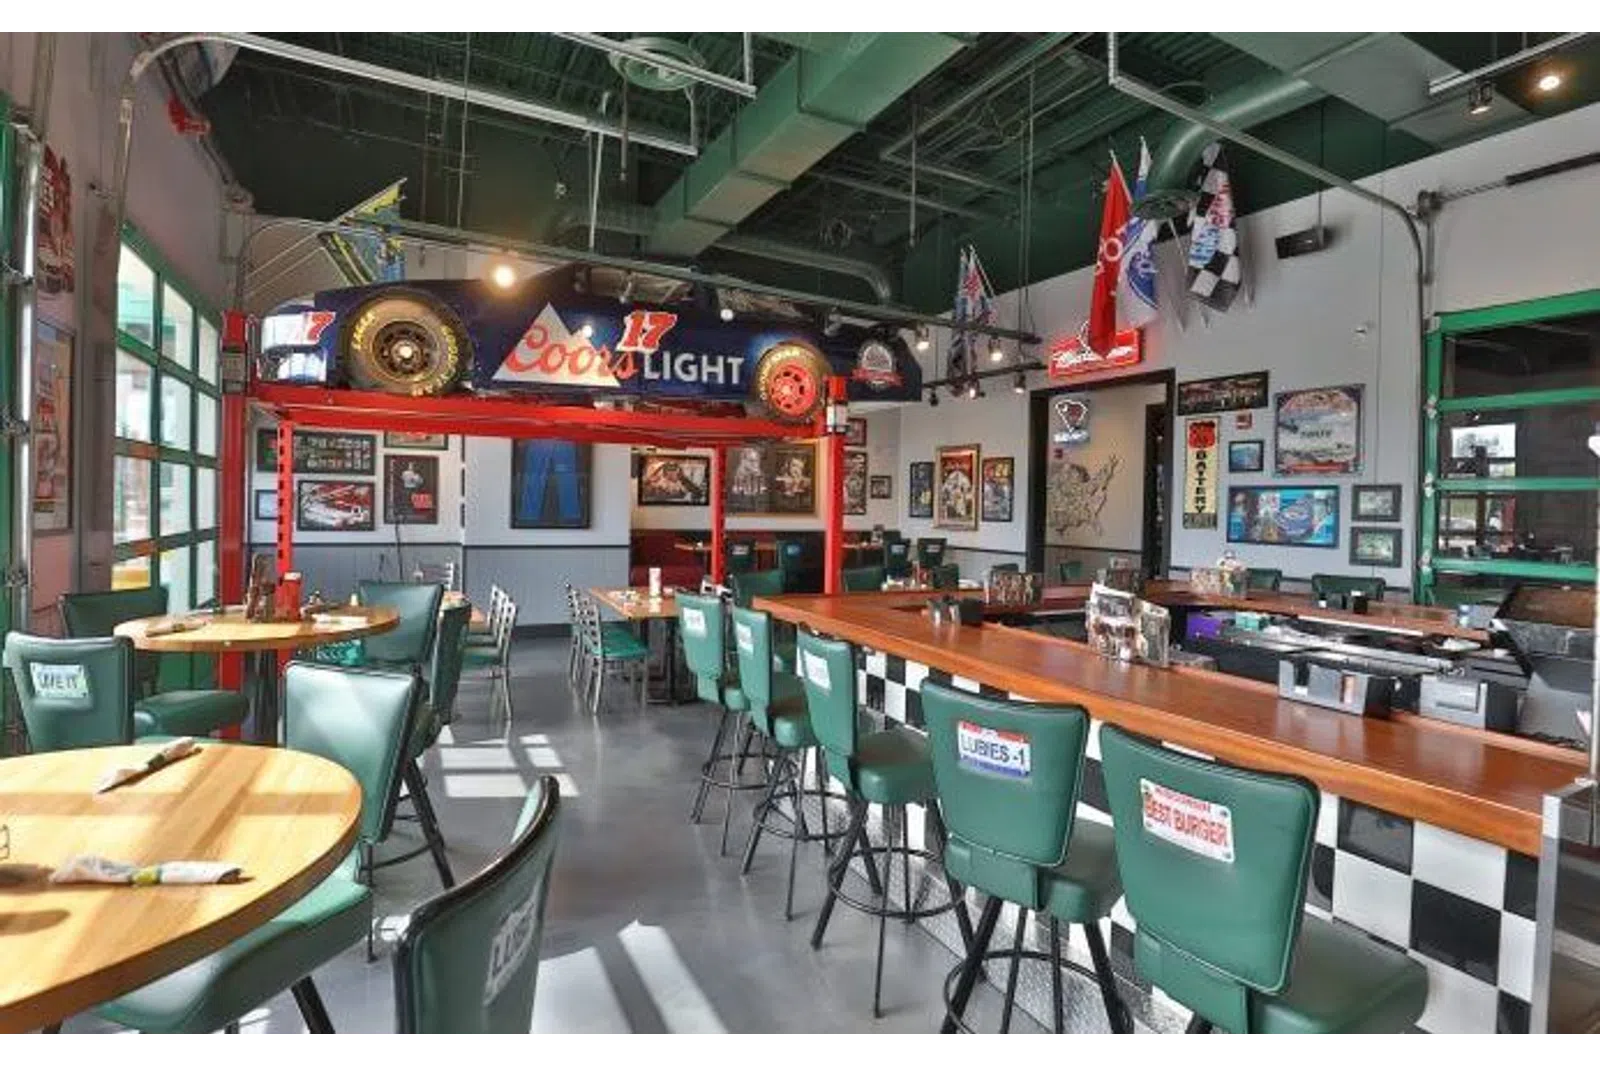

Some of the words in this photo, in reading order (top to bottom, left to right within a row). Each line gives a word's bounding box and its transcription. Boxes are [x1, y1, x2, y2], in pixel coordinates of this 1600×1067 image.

[506, 325, 639, 380] Coors
[643, 352, 745, 384] LIGHT
[616, 310, 678, 352] 17
[1145, 800, 1172, 828] BEST
[1173, 808, 1228, 847] BURGER
